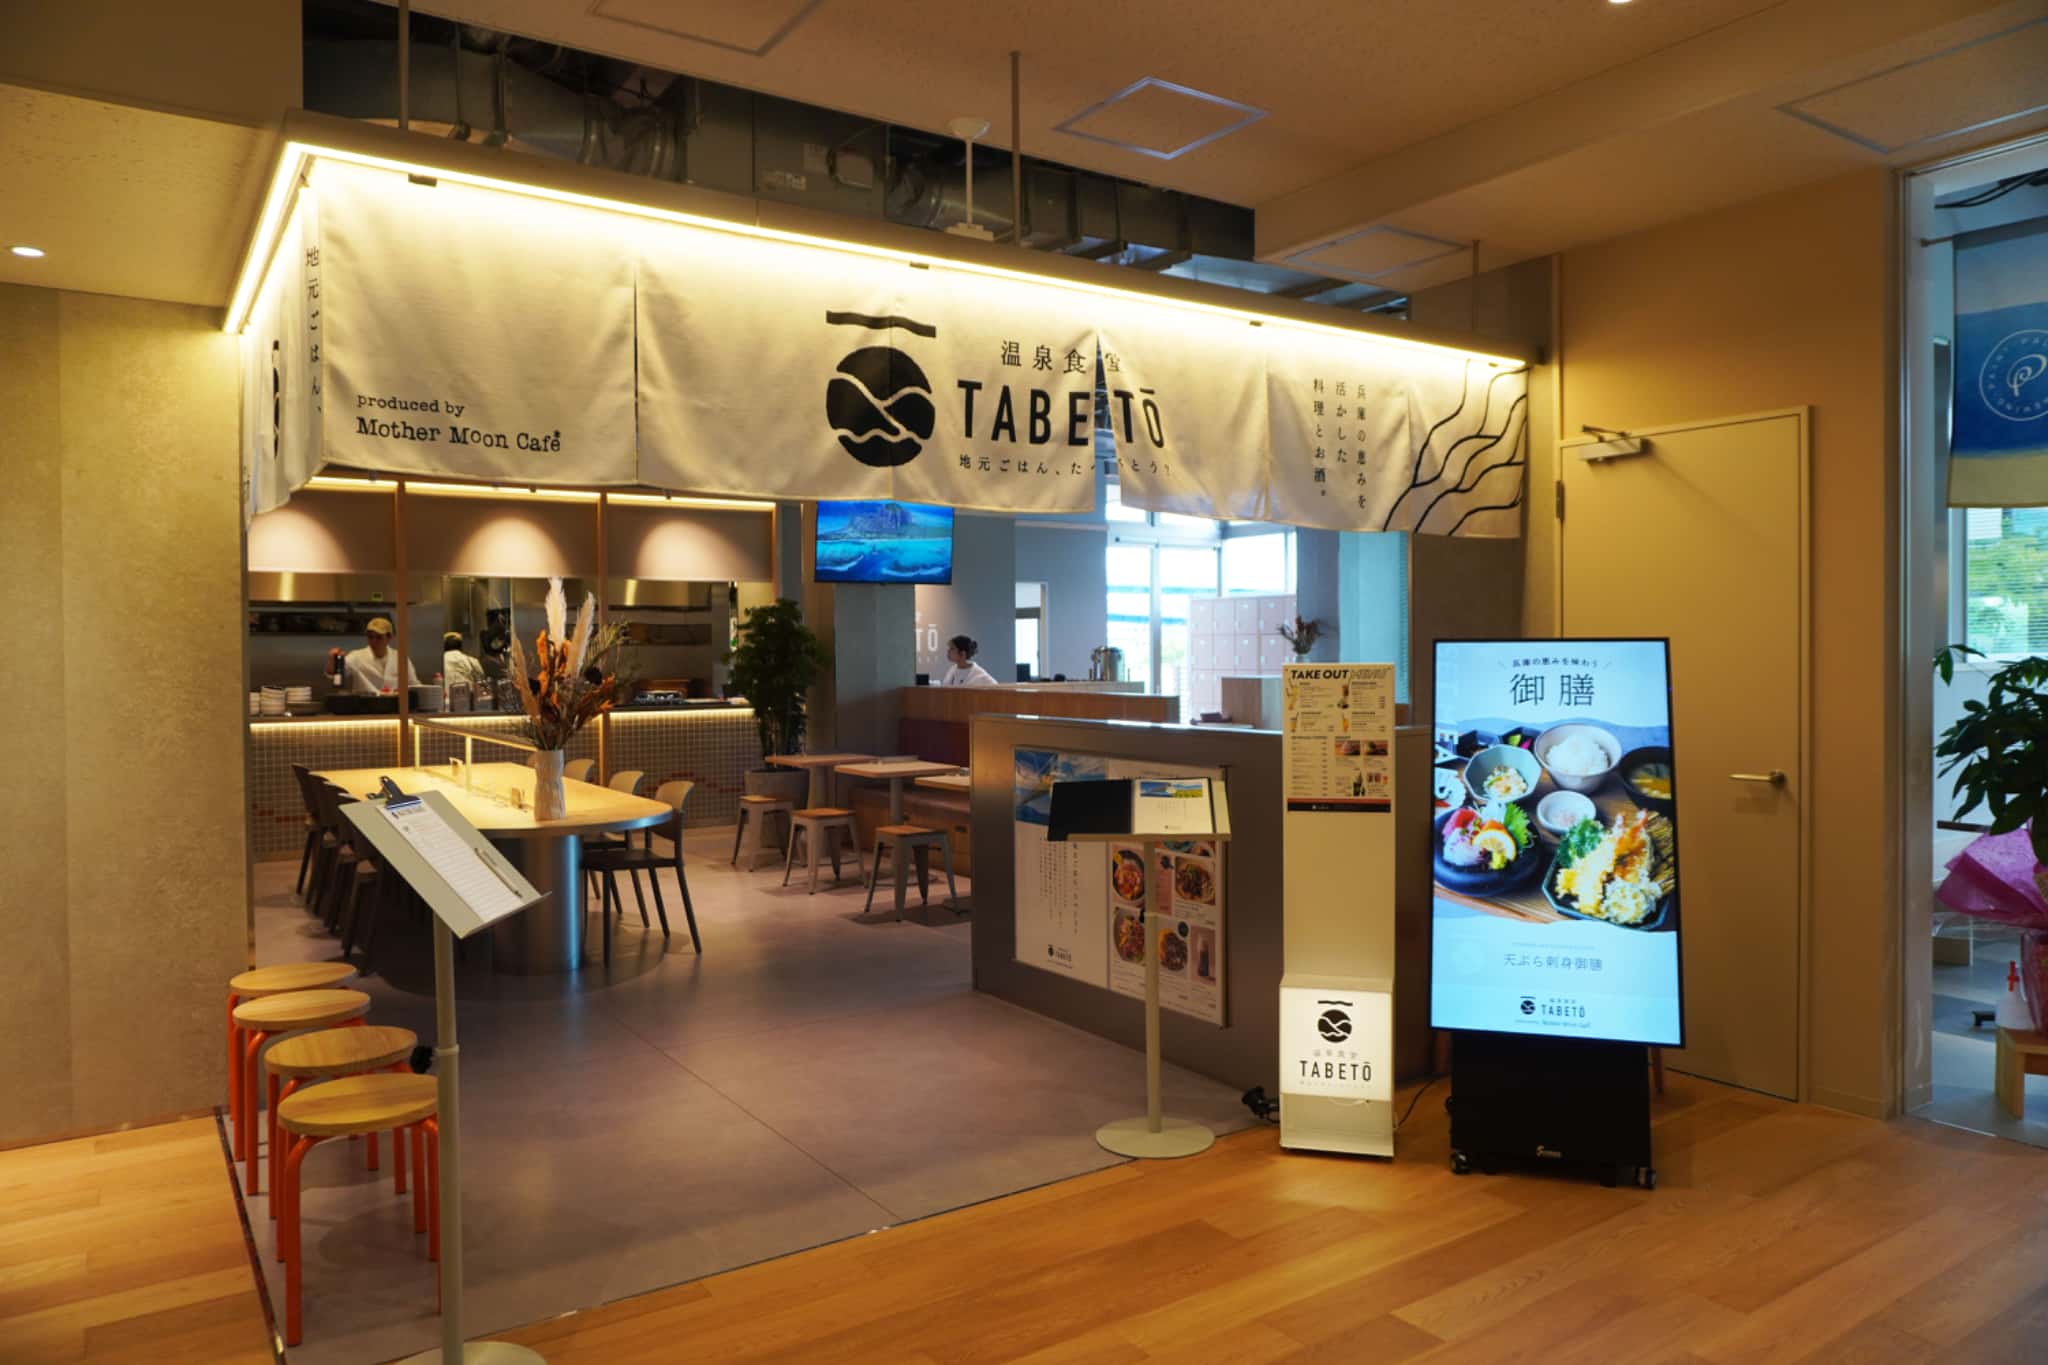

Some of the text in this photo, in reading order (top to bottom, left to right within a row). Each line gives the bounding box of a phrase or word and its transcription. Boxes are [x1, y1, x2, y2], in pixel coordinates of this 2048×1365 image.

[357, 394, 465, 417] produced by
[356, 416, 442, 442] Mother
[449, 426, 509, 449] Moon
[1335, 381, 1348, 464] 活かした
[1290, 669, 1321, 680] TAKE
[1322, 669, 1349, 680] OUT
[1509, 672, 1595, 707] 御膳
[1299, 1060, 1372, 1082] TABETŌ
